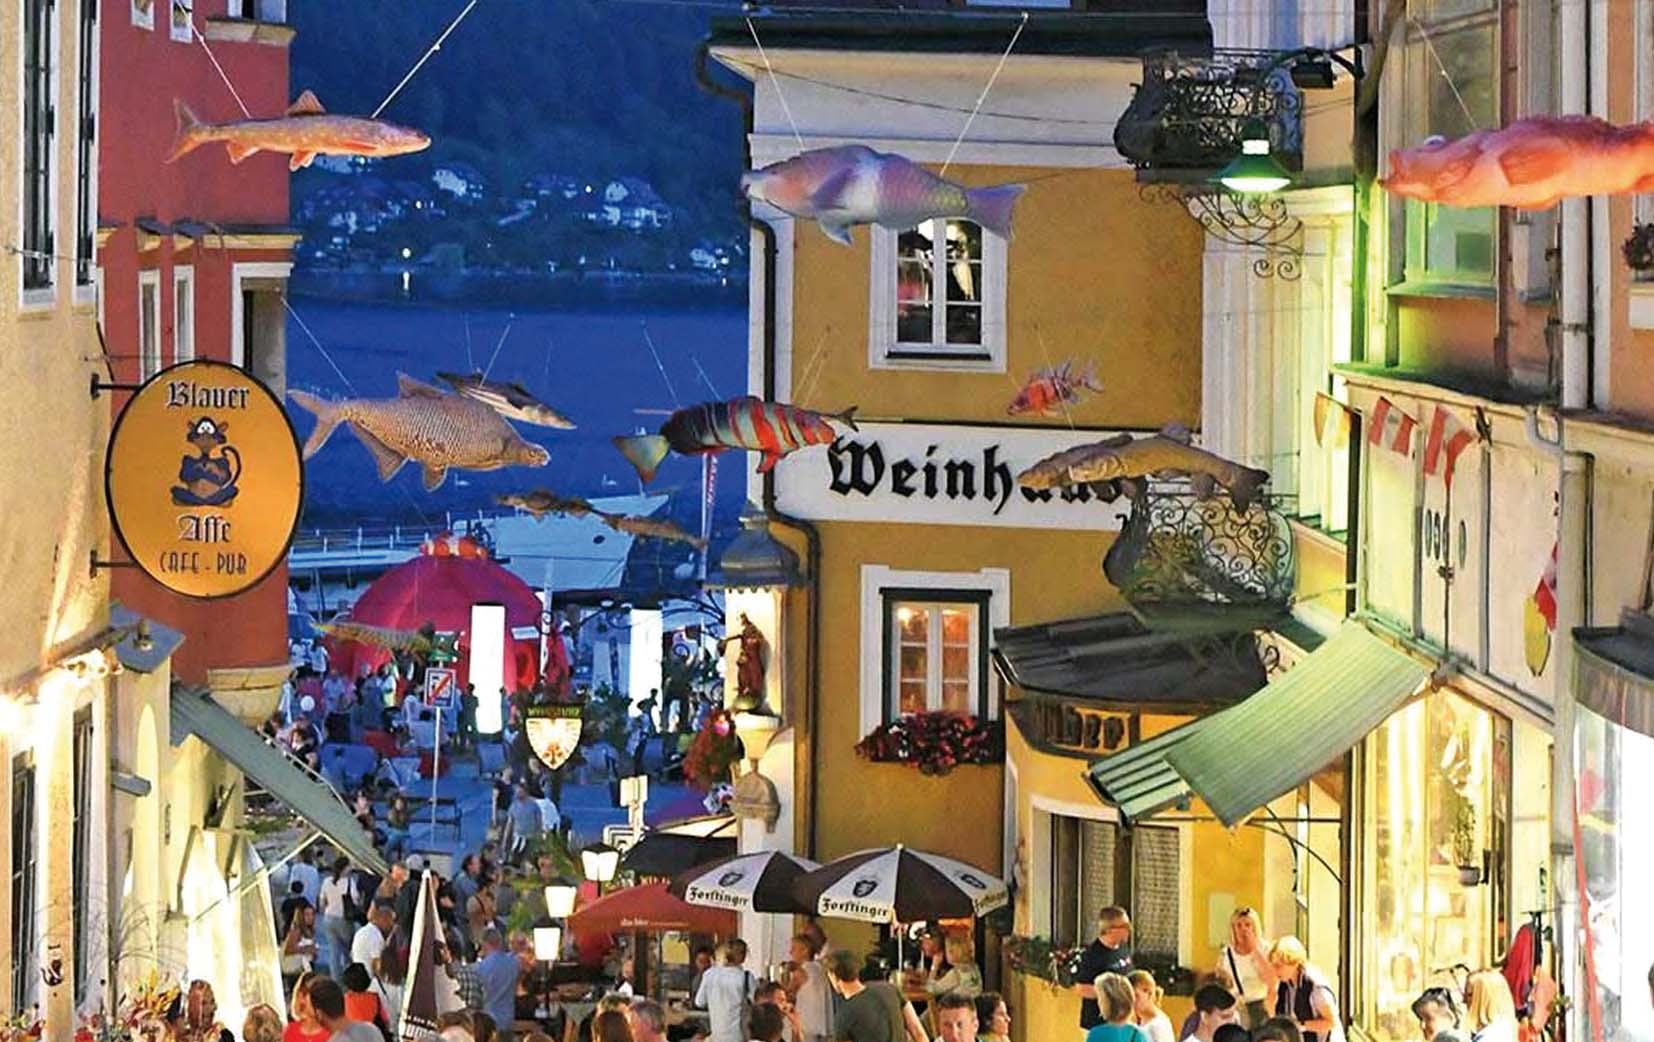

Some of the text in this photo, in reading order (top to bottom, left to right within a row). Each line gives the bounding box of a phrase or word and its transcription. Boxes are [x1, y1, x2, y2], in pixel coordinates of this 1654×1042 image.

[167, 382, 250, 409] Blauer
[178, 515, 231, 543] Affe
[159, 551, 200, 574] CAFE
